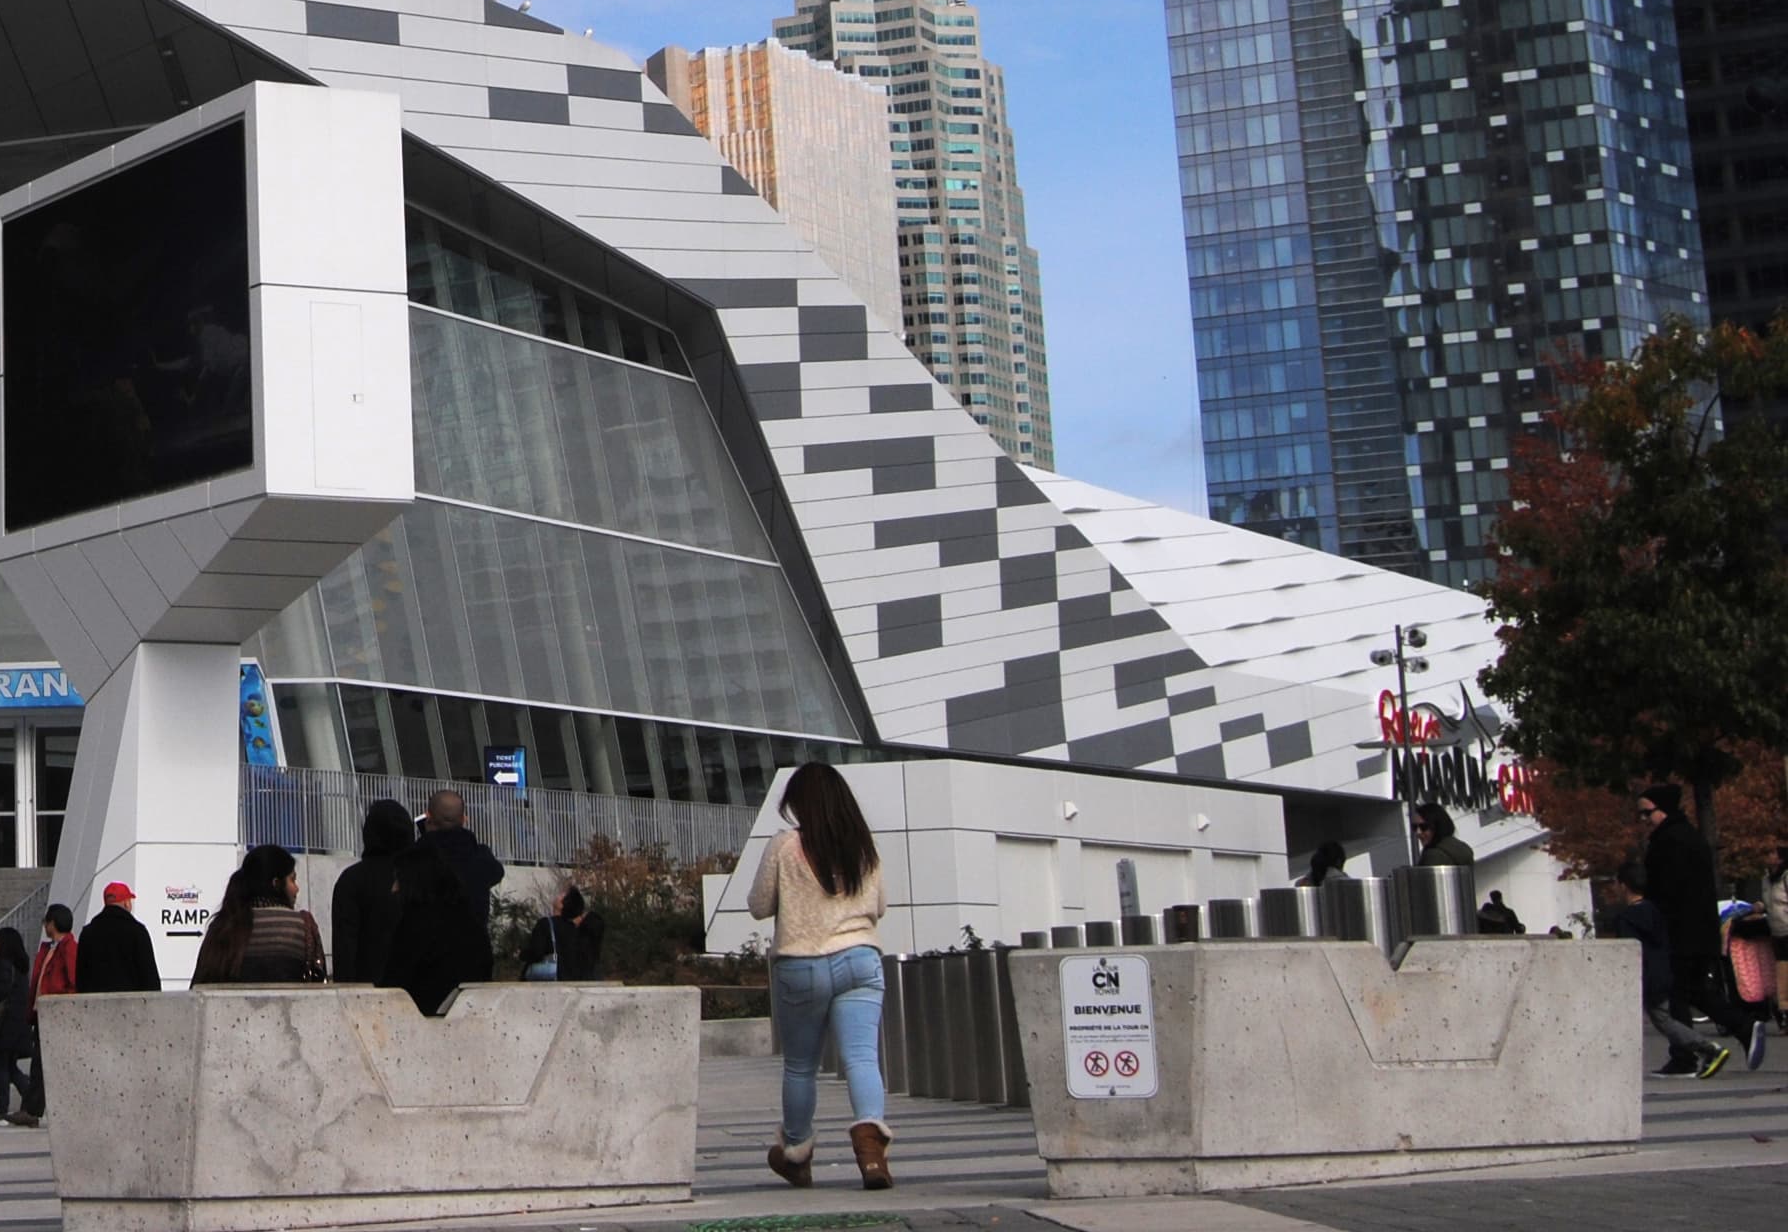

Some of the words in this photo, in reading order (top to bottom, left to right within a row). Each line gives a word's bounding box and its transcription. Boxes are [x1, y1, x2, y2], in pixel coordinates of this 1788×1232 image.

[160, 908, 210, 925] RAMP
[1092, 971, 1120, 988] CN
[1094, 988, 1120, 996] TOWER
[1073, 1003, 1142, 1016] BIENVENUE
